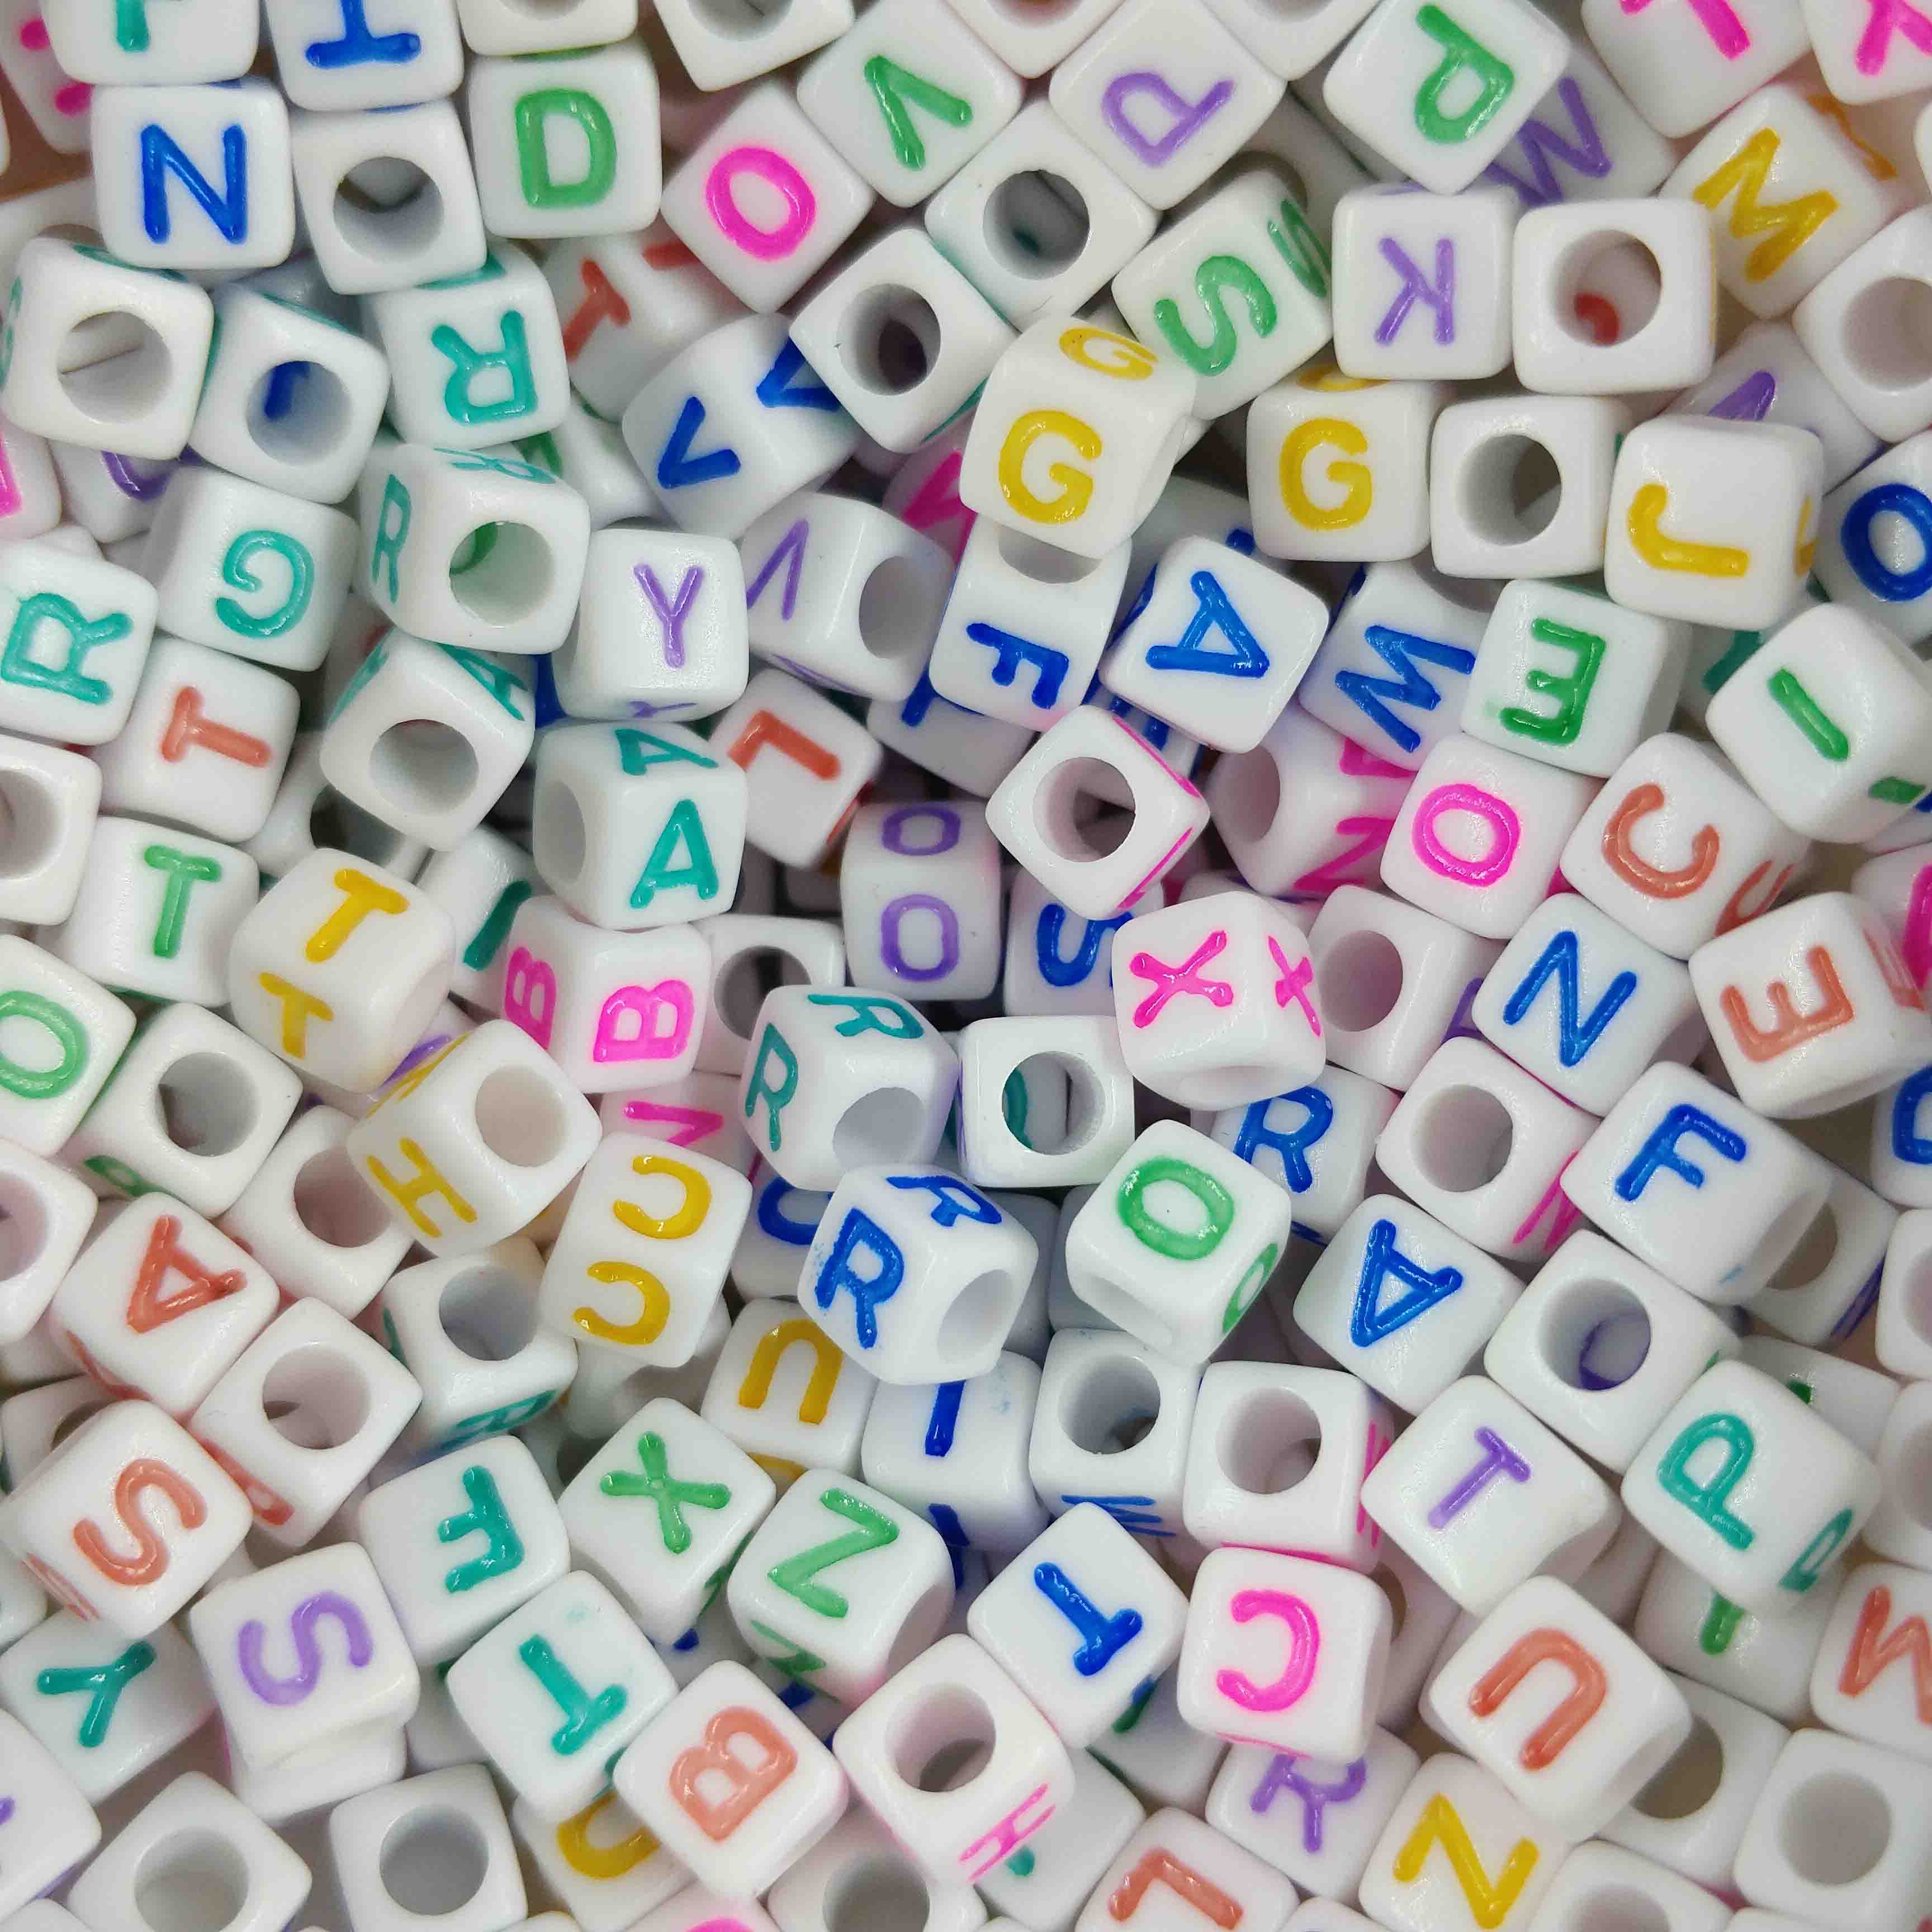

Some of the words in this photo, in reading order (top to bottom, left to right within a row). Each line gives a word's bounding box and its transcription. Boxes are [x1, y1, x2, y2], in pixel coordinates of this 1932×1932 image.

[863, 54, 972, 170] V
[1102, 72, 1234, 163] P
[1415, 3, 1515, 143] P
[139, 123, 248, 245] N
[514, 86, 617, 207] D
[702, 143, 818, 263] O
[1694, 128, 1840, 282] M
[564, 259, 629, 359] T
[1154, 254, 1278, 376] S
[1377, 238, 1455, 344] K
[430, 310, 537, 425] R
[1058, 328, 1159, 380] G
[997, 409, 1104, 525] G
[1278, 416, 1374, 532] G
[215, 529, 313, 639] G
[373, 477, 408, 599] R
[746, 521, 808, 620] V
[1627, 482, 1753, 579] J
[1842, 483, 1932, 602] O
[0, 593, 132, 705] R
[635, 565, 703, 666] Y
[966, 622, 1070, 713] F
[1145, 570, 1271, 679] A
[160, 689, 269, 766] T
[1497, 617, 1607, 746] E
[1768, 667, 1852, 761] I
[614, 728, 718, 775] A
[729, 712, 840, 780] L
[628, 799, 718, 909] A
[881, 804, 962, 854] O
[1410, 782, 1522, 889] O
[1604, 785, 1720, 898] C
[143, 845, 220, 958] T
[301, 868, 409, 964] T
[880, 894, 959, 983] O
[258, 972, 334, 1060] T
[502, 945, 558, 1051] B
[590, 978, 695, 1064] B
[808, 995, 921, 1038] R
[1128, 930, 1235, 1029] X
[1266, 935, 1323, 1038] X
[1503, 930, 1637, 1068] N
[1722, 948, 1854, 1060] E
[746, 1022, 798, 1149] R
[1234, 1086, 1333, 1194] R
[366, 1137, 477, 1238] H
[886, 1174, 1002, 1229] R
[1614, 1103, 1749, 1202] F
[1116, 1156, 1235, 1262] O
[126, 1217, 242, 1333] A
[814, 1208, 906, 1350] R
[1351, 1219, 1465, 1348] A
[737, 1319, 843, 1426] U
[72, 1458, 208, 1587] S
[438, 1467, 523, 1593] F
[599, 1432, 730, 1554] X
[1431, 1427, 1530, 1527] T
[1660, 1413, 1754, 1550] P
[769, 1489, 899, 1619] Z
[238, 1593, 371, 1704] S
[1033, 1562, 1144, 1678] T
[1216, 1588, 1322, 1715] C
[36, 1641, 156, 1748] Y
[519, 1635, 626, 1756] T
[1472, 1631, 1607, 1771] U
[670, 1706, 798, 1843] B
[959, 1784, 1057, 1881] H
[1109, 1852, 1243, 1932] L
